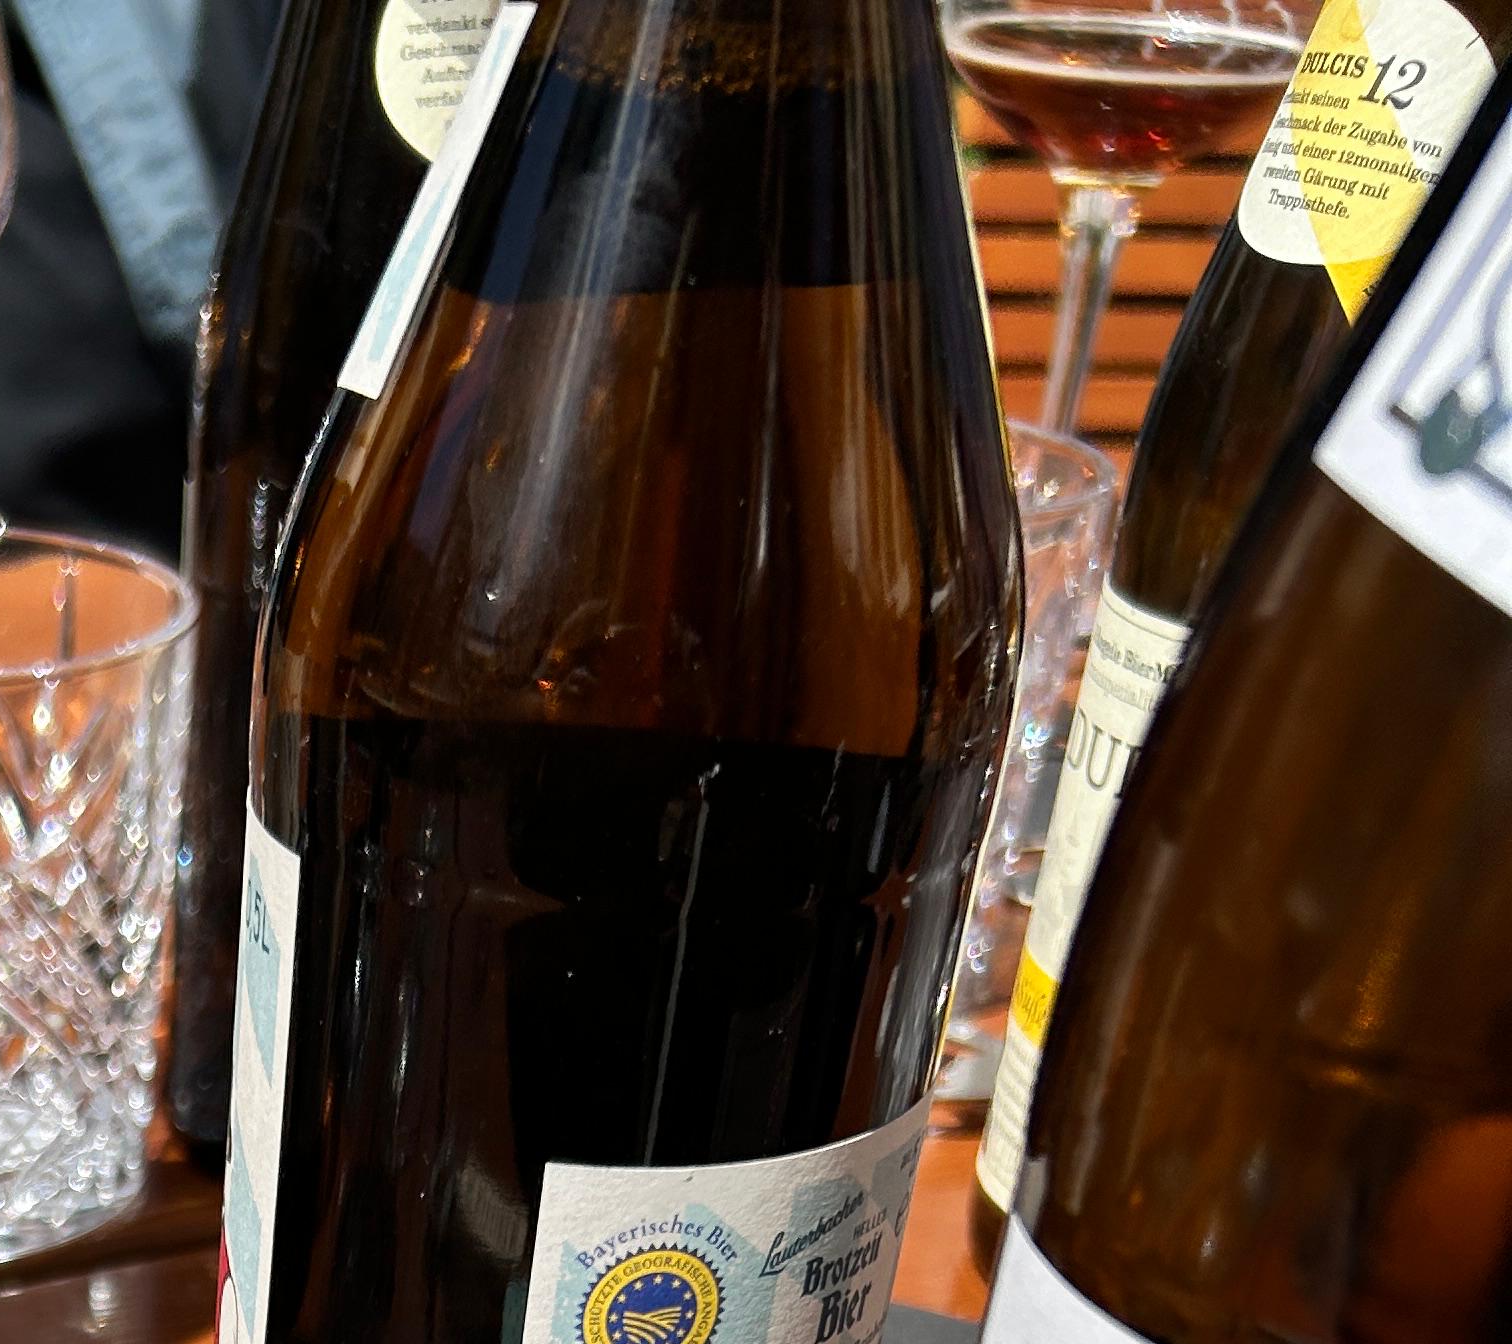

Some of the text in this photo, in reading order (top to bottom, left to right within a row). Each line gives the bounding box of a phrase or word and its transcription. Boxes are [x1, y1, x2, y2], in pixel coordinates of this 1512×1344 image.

[1301, 52, 1427, 110] DULCIS 12
[1311, 91, 1350, 109] seinen
[1302, 143, 1334, 161] einer
[1323, 117, 1443, 158] der Zugabe von
[1267, 188, 1350, 219] Trappisthefe.
[1303, 168, 1359, 196] Gärung
[1360, 184, 1390, 200] mit
[576, 1214, 739, 1270] Bayerisches Bier
[759, 1190, 864, 1278] Lauterbacher
[623, 1256, 713, 1297] GEOGRAFISCHE
[800, 1231, 883, 1299] Brotzeit
